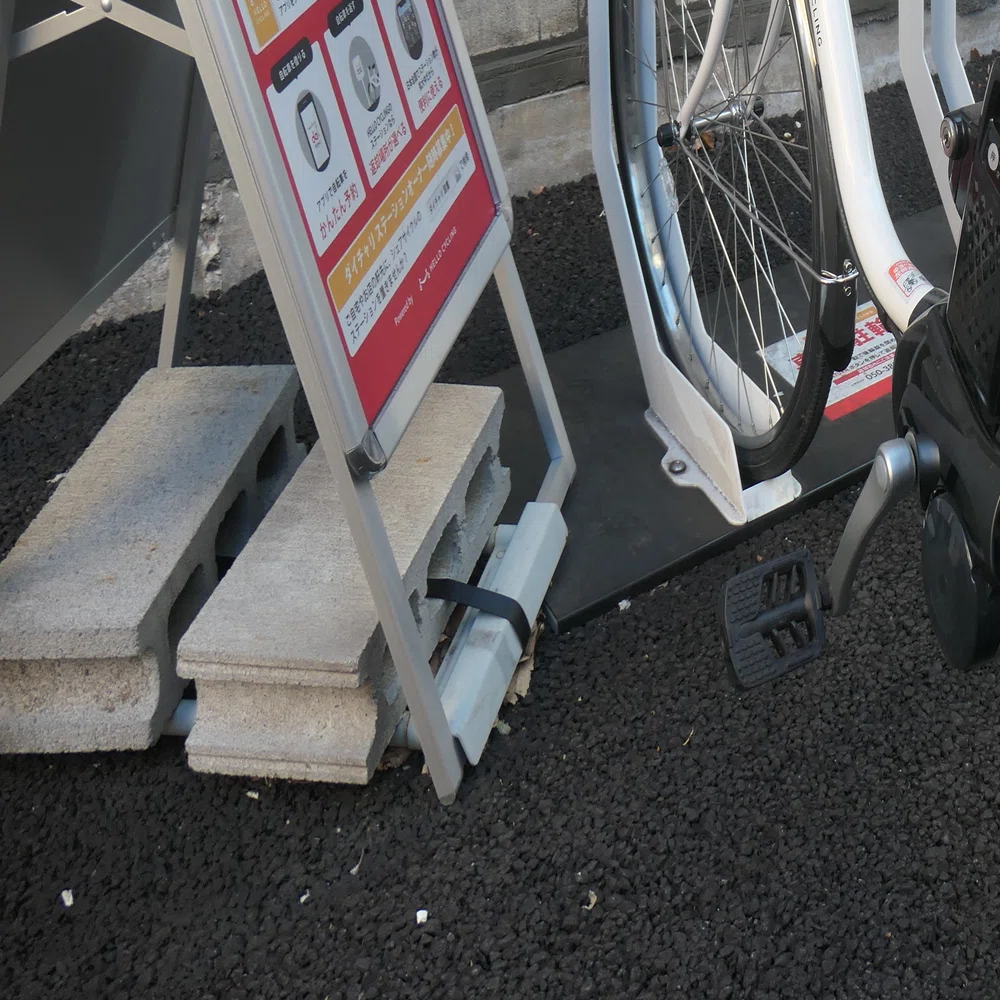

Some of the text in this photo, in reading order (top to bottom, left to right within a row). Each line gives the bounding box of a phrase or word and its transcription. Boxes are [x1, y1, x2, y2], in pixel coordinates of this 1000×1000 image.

[278, 48, 307, 81] 自転車を借りる
[418, 76, 444, 113] 便利に使える
[316, 168, 349, 213] アプリで自転車を
[319, 182, 359, 240] かんたん予約
[429, 226, 458, 273] HELLO CYCLING
